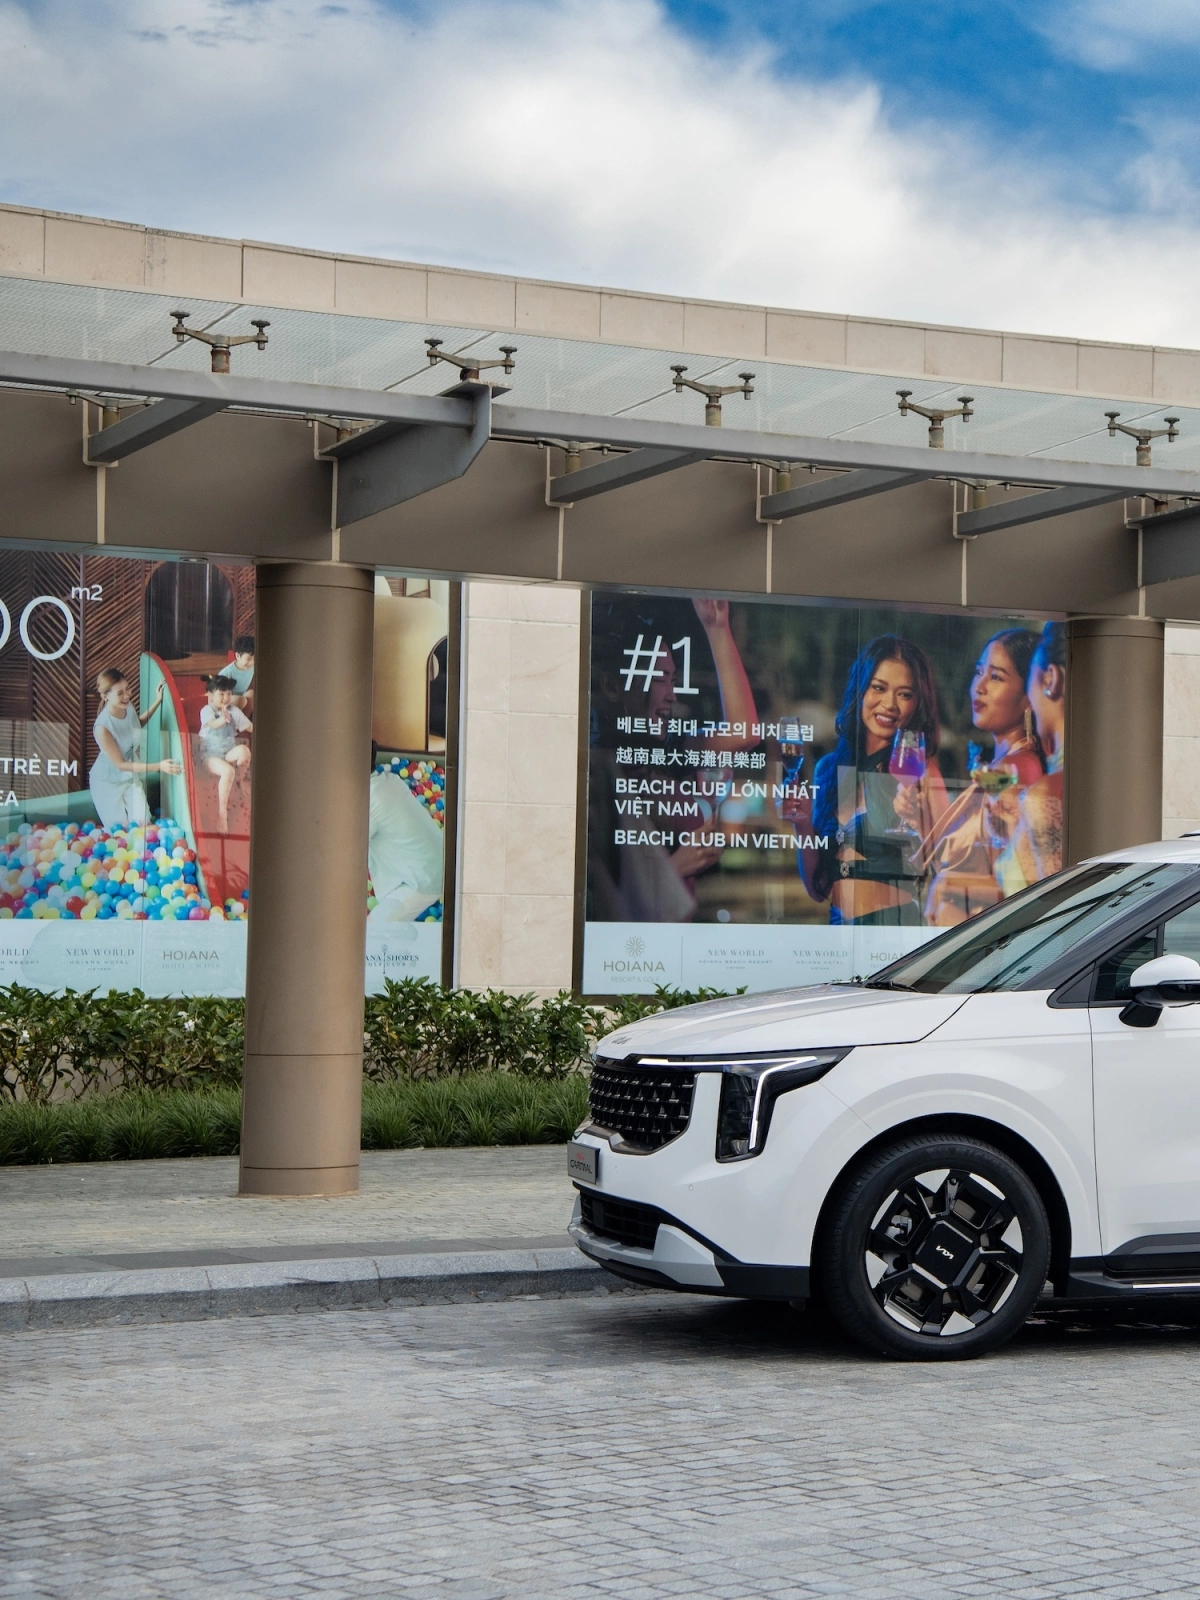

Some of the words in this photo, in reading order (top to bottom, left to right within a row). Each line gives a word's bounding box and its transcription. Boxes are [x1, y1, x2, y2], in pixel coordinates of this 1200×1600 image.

[0, 595, 75, 661] 0
[71, 584, 103, 601] m2
[619, 634, 699, 695] #1
[616, 716, 663, 736] 베트남
[667, 718, 698, 737] 최대
[701, 720, 747, 739] 규모의
[751, 722, 780, 741] 비치
[784, 724, 814, 742] 클럽
[0, 753, 41, 775] TRẺ
[47, 759, 78, 777] EM
[616, 746, 766, 770] 越南最大海灘俱樂部
[615, 778, 675, 795] BEACH
[679, 781, 727, 797] CLUB
[731, 779, 767, 799] LỚN
[771, 779, 820, 800] NHẤT
[615, 796, 654, 818] VIỆT
[658, 801, 698, 816] NAM
[614, 829, 674, 846] BEACH
[678, 831, 726, 848] CLUB
[730, 833, 748, 848] IN
[752, 833, 829, 850] VIETNAM
[66, 948, 88, 957] NEW
[93, 948, 135, 957] WORLD
[163, 950, 219, 961] HOIANA
[708, 949, 727, 957] NEW
[730, 949, 765, 957] WORLD
[603, 960, 666, 972] HOIANA
